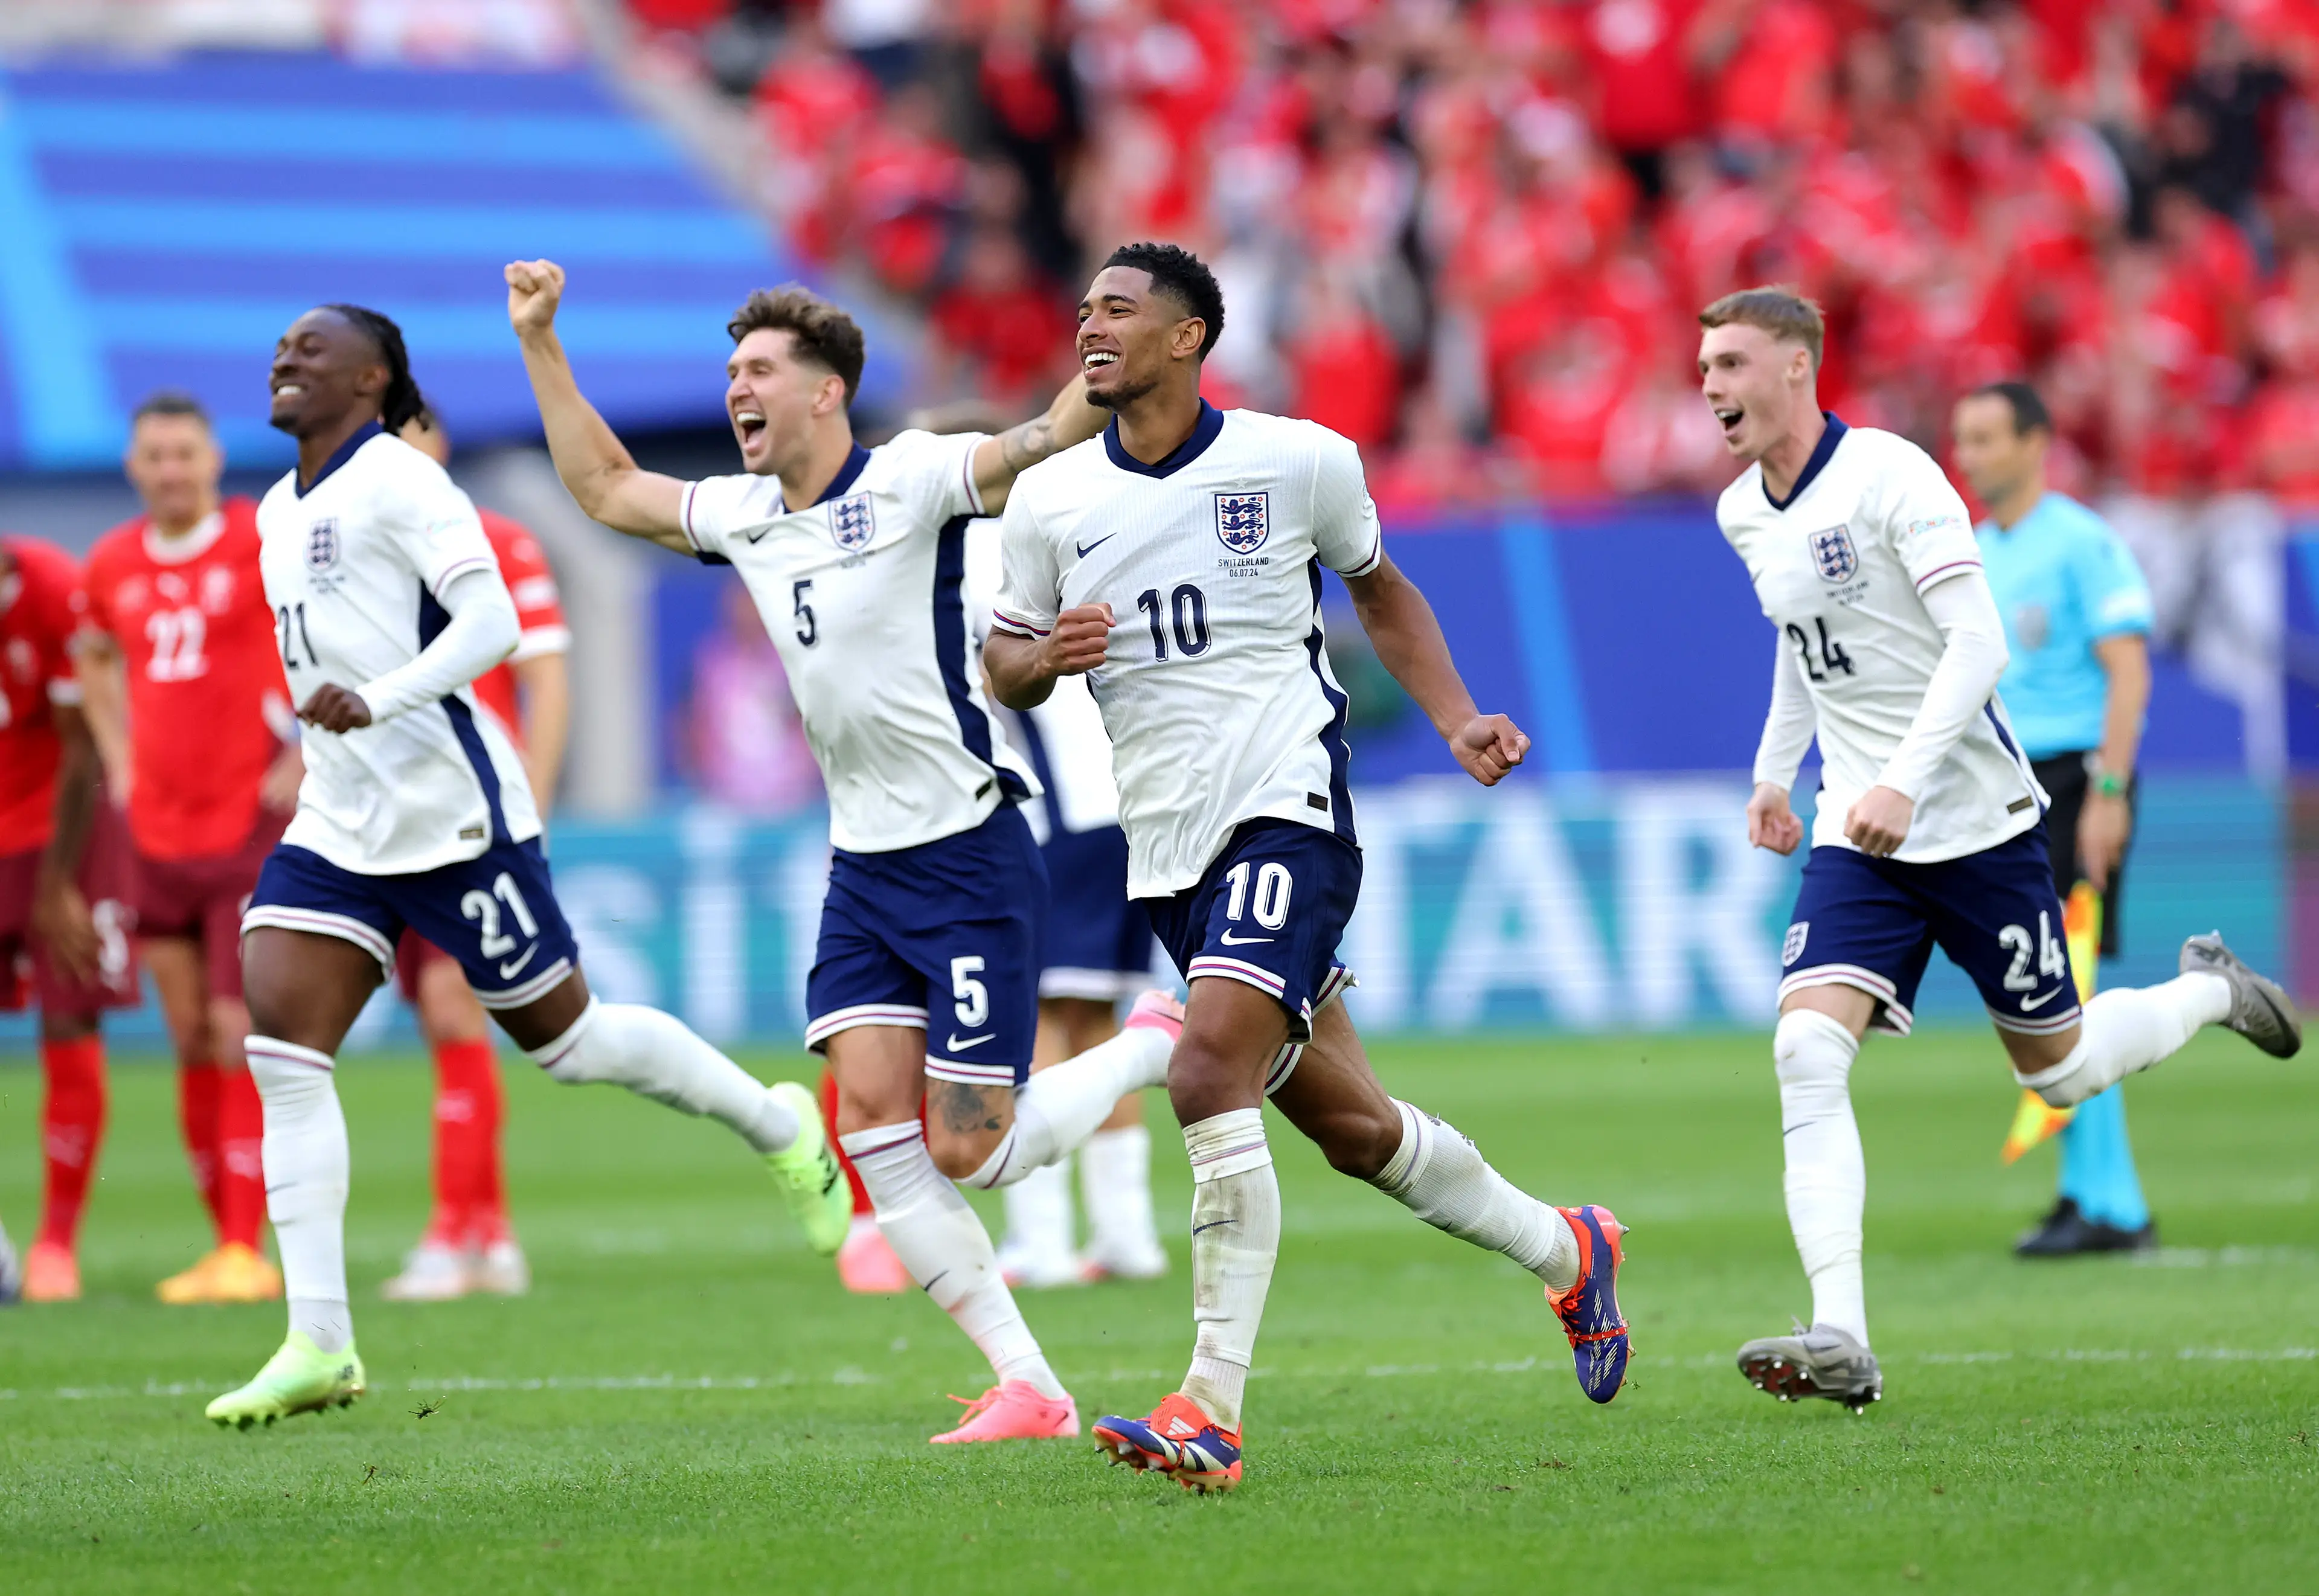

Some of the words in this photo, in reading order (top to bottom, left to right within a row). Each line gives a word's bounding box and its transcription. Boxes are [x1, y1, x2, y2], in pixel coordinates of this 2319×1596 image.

[1217, 557, 1269, 568] SWITZERLAND
[1229, 569, 1259, 578] 06.07.24
[145, 606, 210, 683] 22
[277, 603, 318, 671] 21
[793, 579, 817, 647] 5
[1137, 583, 1212, 662] 10
[1786, 616, 1856, 682] 24
[460, 872, 539, 959] 21
[1225, 861, 1294, 931] 10
[1998, 909, 2066, 991] 24
[950, 955, 989, 1028] 5
